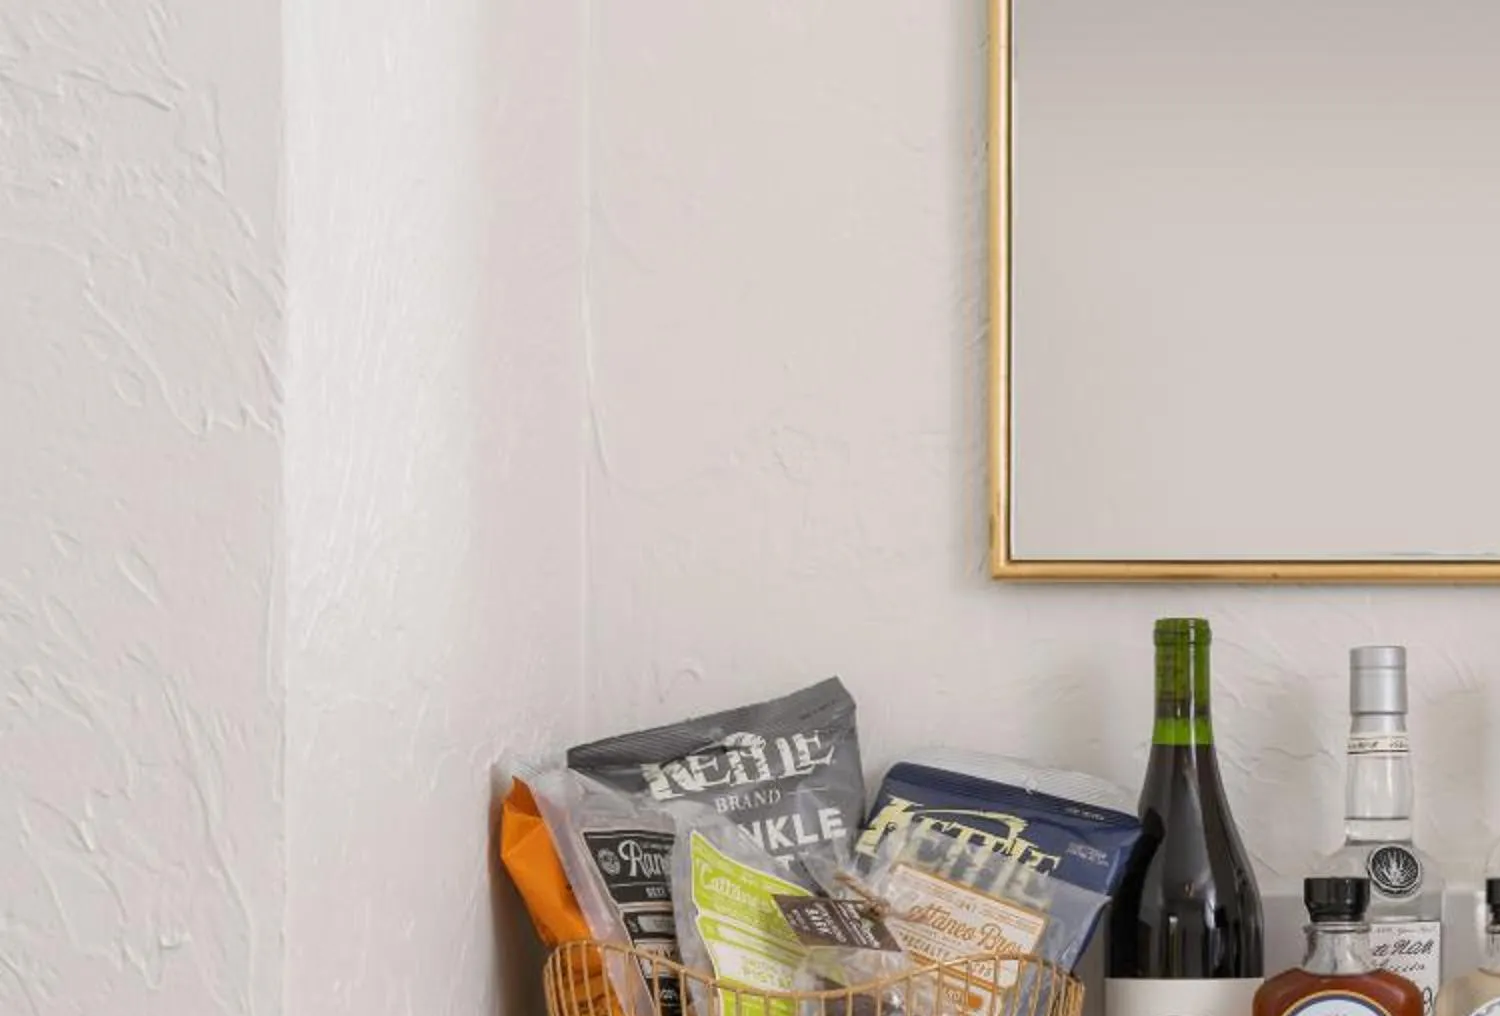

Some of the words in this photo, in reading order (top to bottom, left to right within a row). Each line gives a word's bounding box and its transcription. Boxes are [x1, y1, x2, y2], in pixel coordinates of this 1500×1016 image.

[640, 729, 835, 801] KETTLE
[714, 788, 782, 814] BRAND
[738, 807, 847, 850] NKLE
